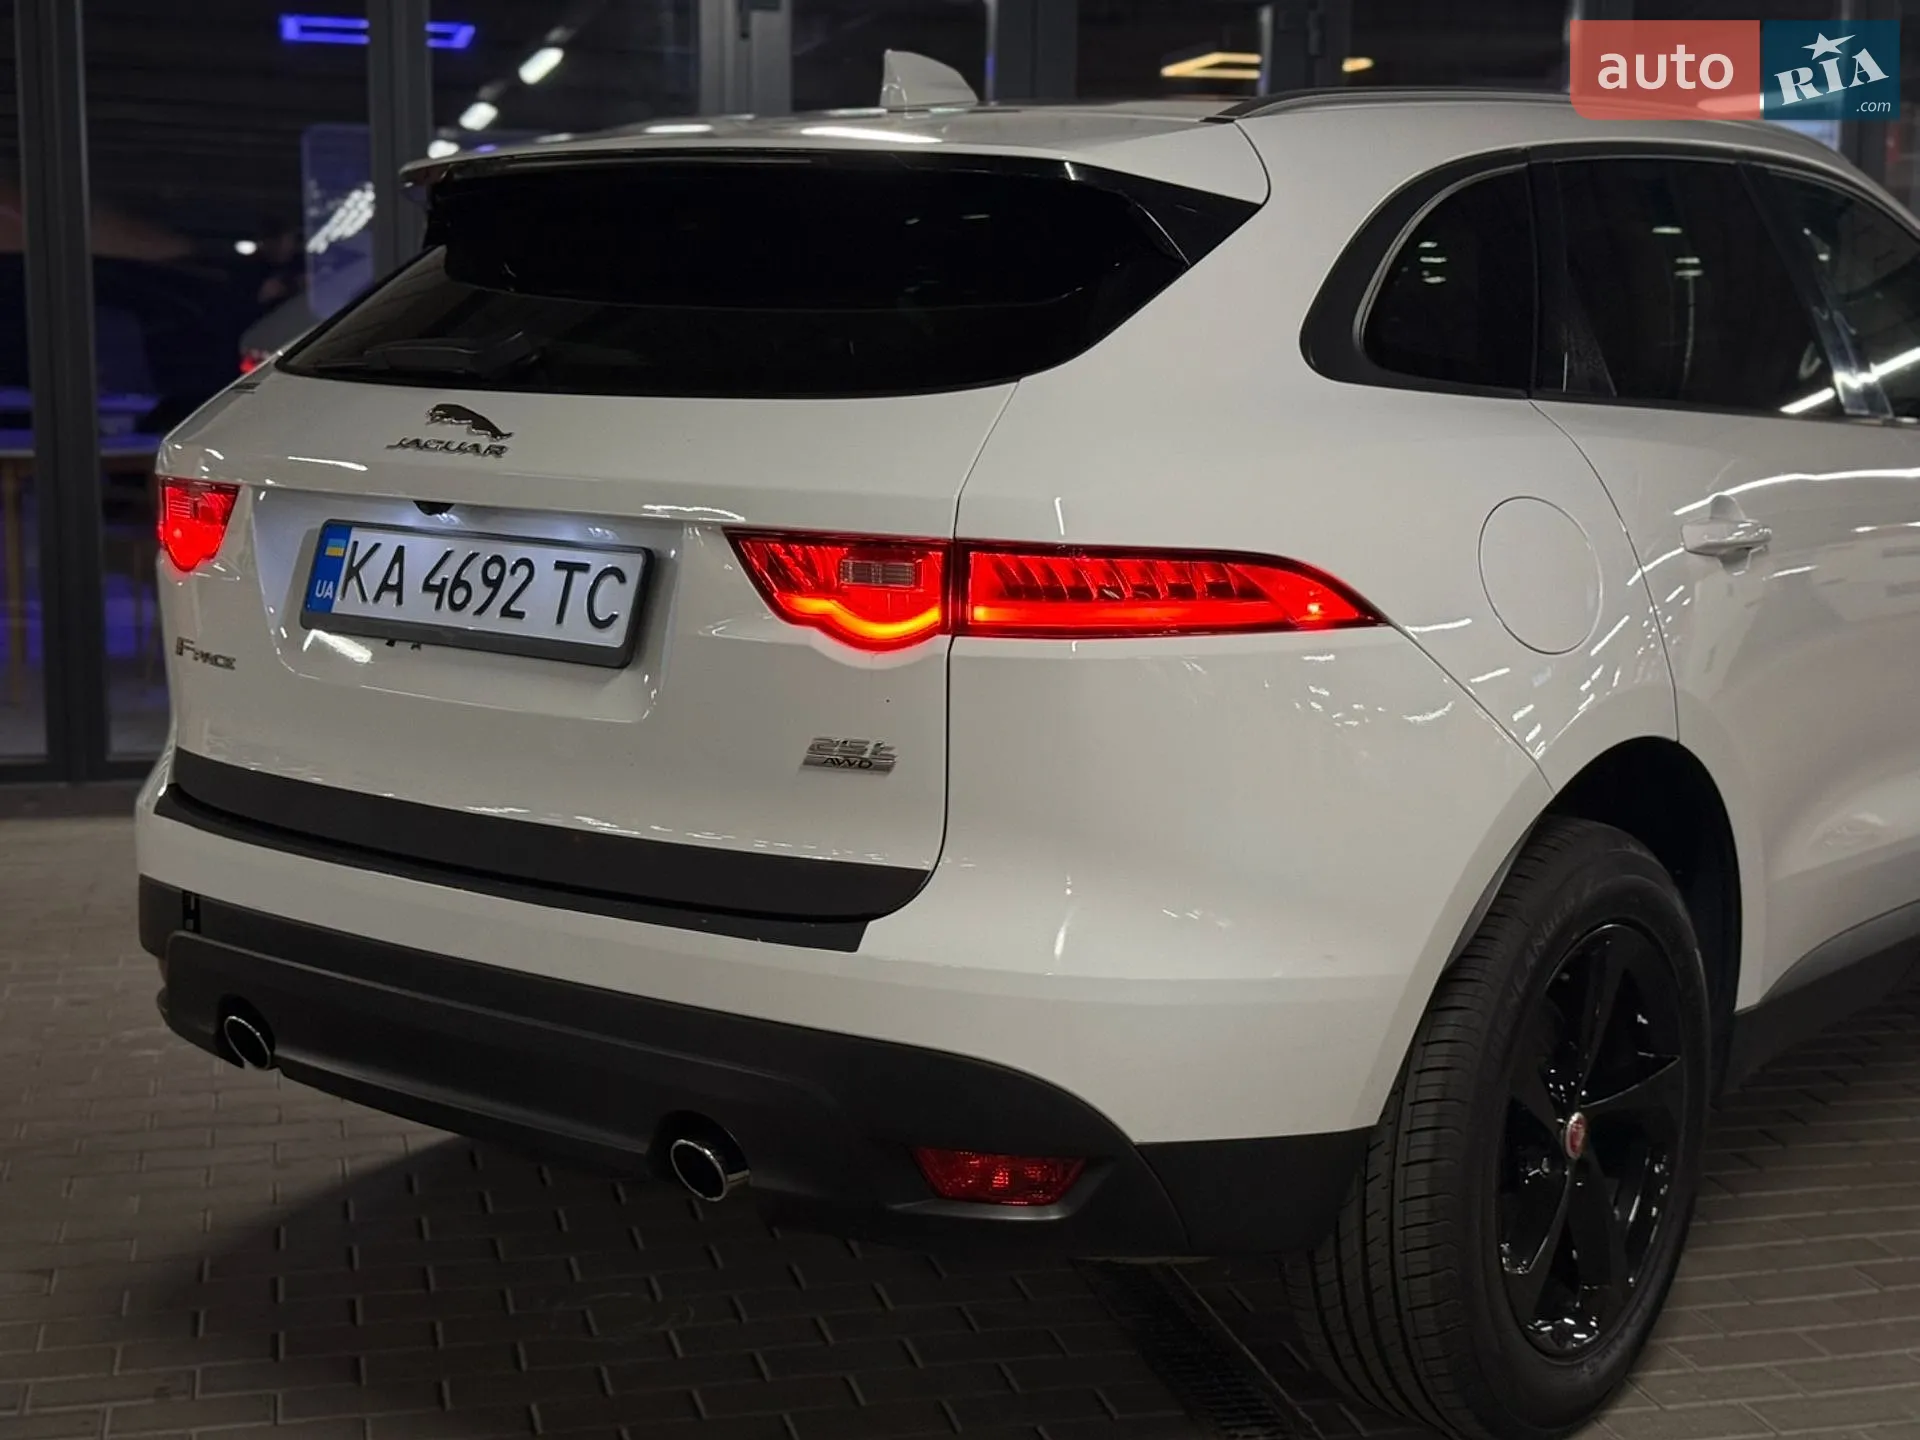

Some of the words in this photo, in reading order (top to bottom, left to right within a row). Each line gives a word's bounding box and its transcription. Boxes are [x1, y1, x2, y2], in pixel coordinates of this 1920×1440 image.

[385, 437, 508, 458] JAGUAR
[314, 579, 334, 600] UA
[339, 540, 405, 608] KA
[421, 548, 536, 620] 4692
[553, 560, 628, 630] TC
[822, 757, 873, 770] AWD
